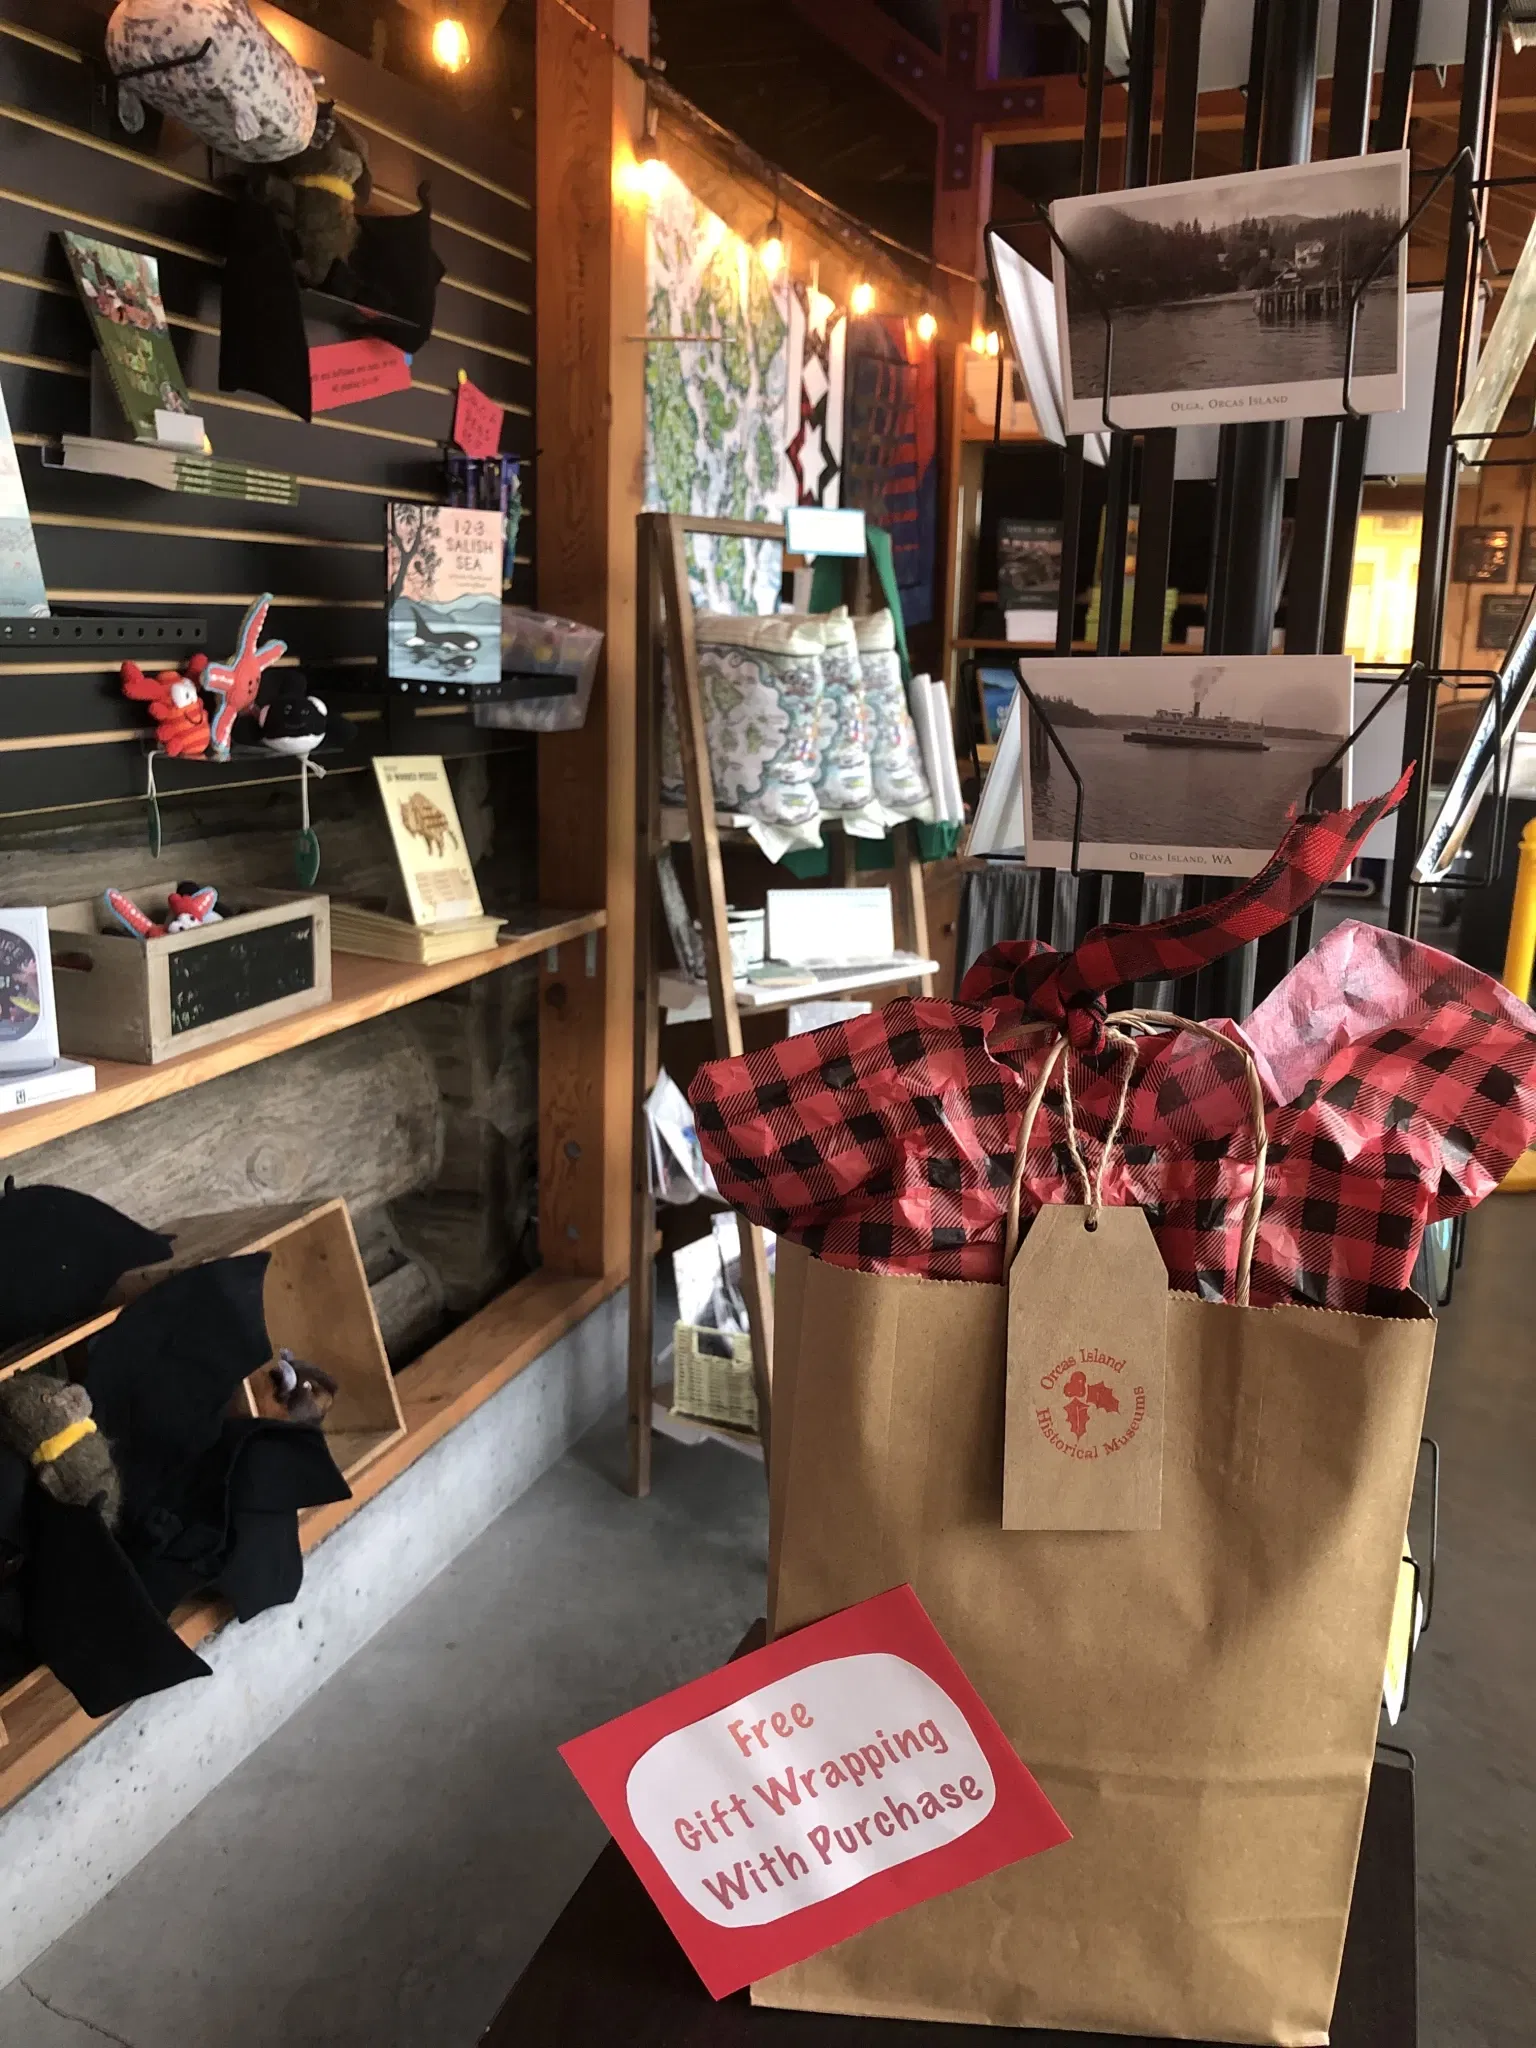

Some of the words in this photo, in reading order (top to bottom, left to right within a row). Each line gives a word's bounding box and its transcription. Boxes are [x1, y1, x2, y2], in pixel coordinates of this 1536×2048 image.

[446, 536, 494, 555] SALISH
[455, 555, 483, 572] SEA
[1211, 854, 1233, 865] WA
[1040, 1356, 1077, 1390] Orcas
[1079, 1347, 1127, 1374] Island
[1035, 1407, 1099, 1460] Historical
[1102, 1385, 1146, 1456] Museums
[726, 1701, 815, 1758] Free
[673, 1793, 755, 1852] Gift
[751, 1718, 949, 1816] Wrapping
[701, 1844, 810, 1911] With
[806, 1774, 984, 1866] Purchase
